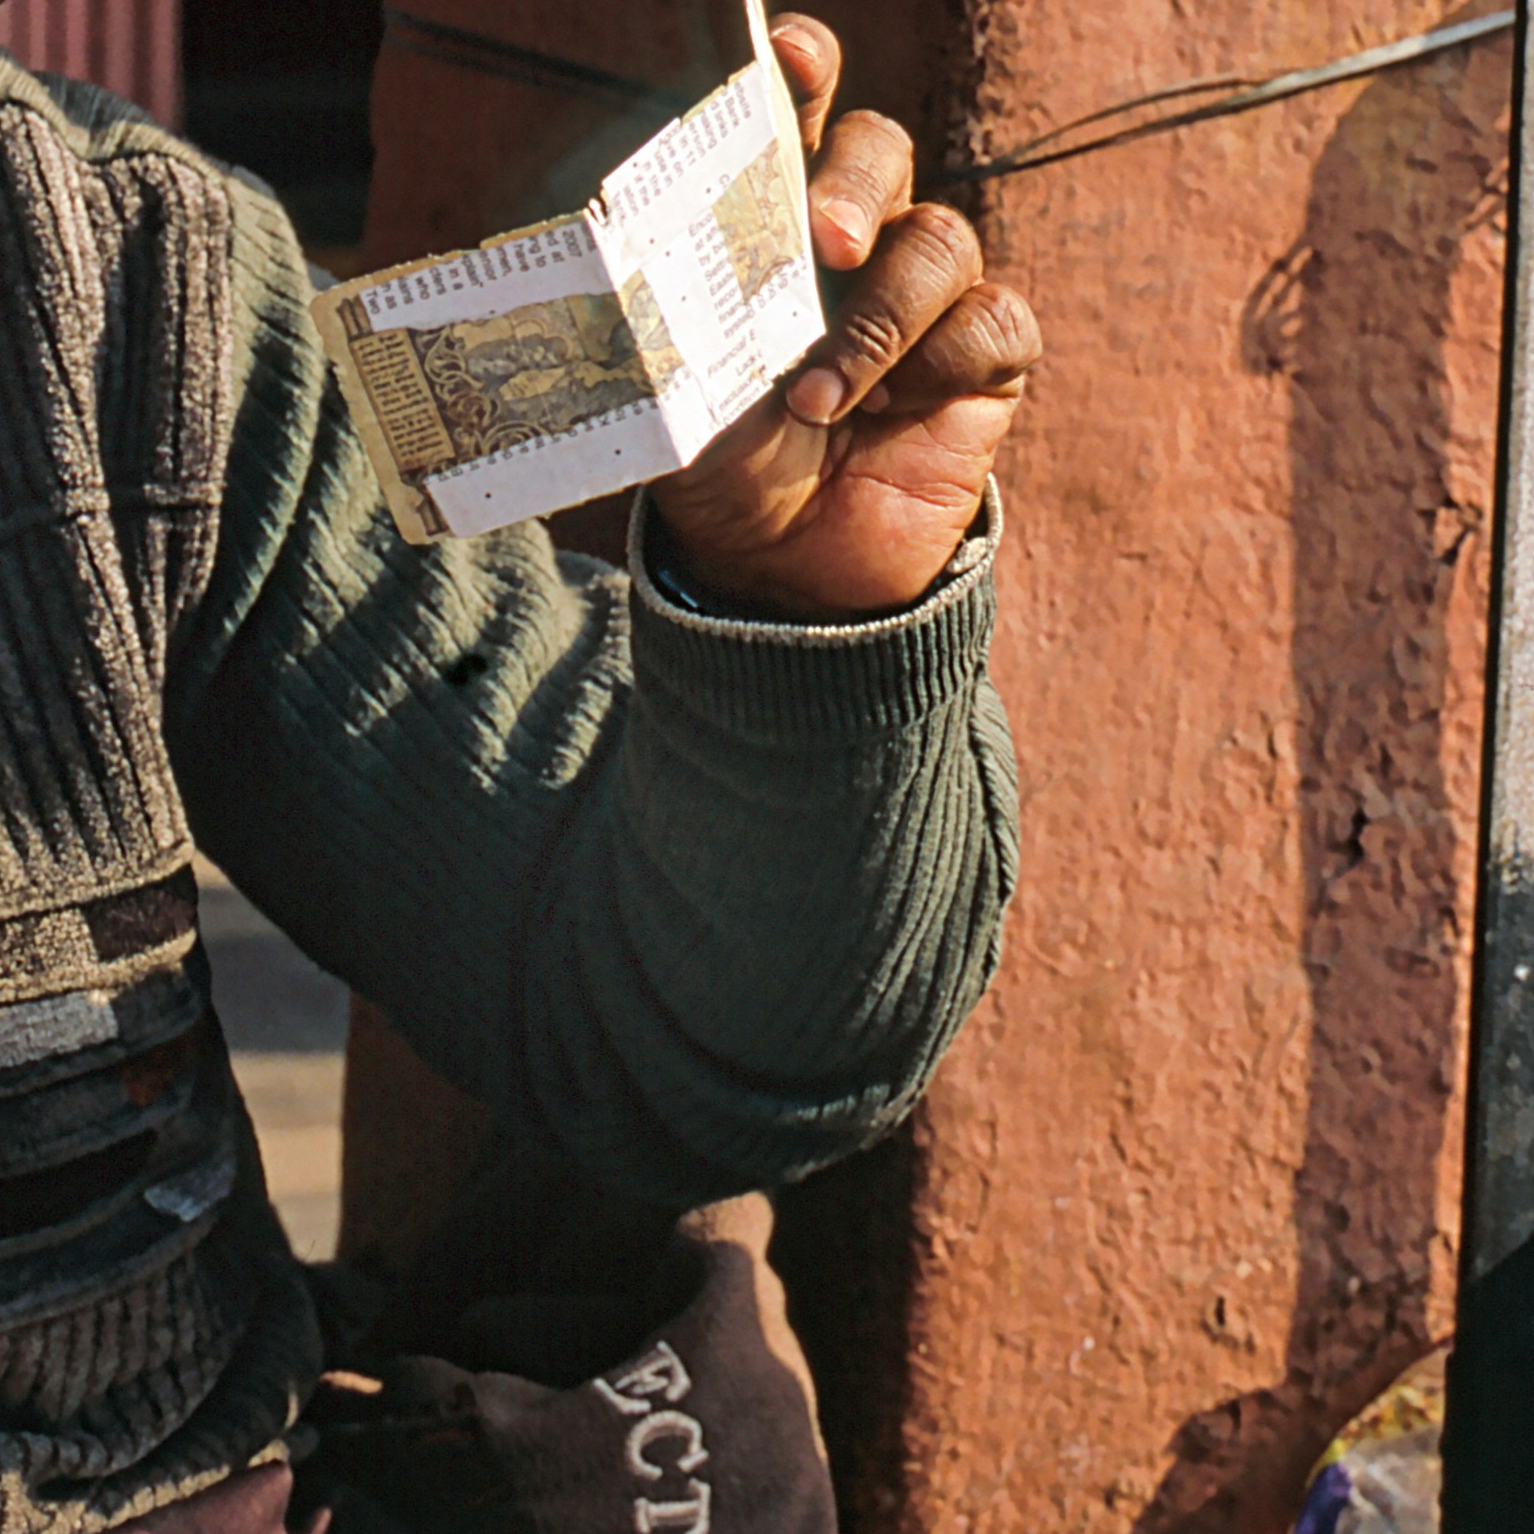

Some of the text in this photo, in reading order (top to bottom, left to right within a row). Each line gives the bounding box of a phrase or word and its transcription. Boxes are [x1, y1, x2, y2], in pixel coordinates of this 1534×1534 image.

[561, 227, 583, 260] 2007
[511, 241, 531, 274] have
[533, 254, 548, 269] to
[549, 248, 566, 264] at
[447, 266, 462, 280] in
[413, 274, 432, 301] who
[364, 288, 383, 315] Two
[383, 294, 398, 310] as
